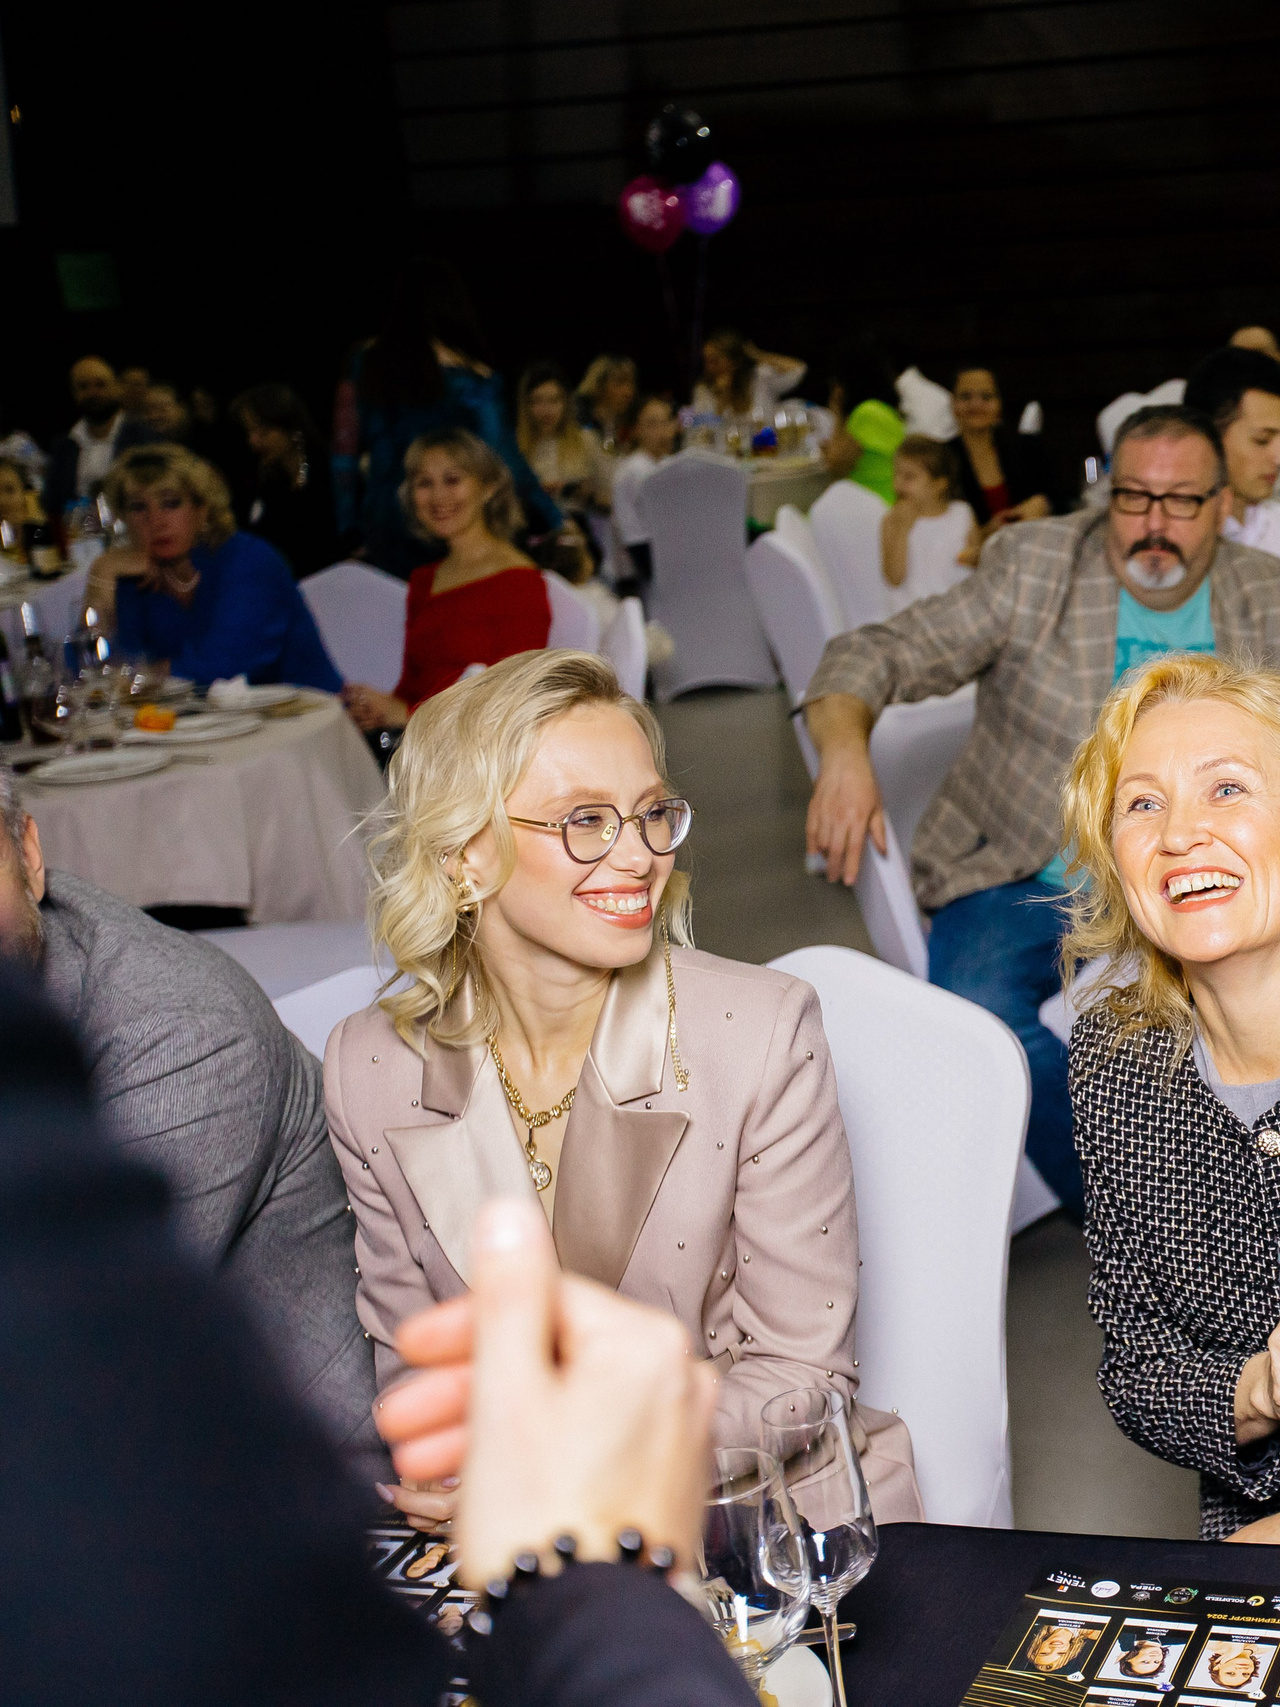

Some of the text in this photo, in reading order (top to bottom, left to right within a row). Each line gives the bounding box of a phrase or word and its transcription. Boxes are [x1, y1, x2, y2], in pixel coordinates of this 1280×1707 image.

[1059, 1570, 1082, 1580] HOTEL
[1047, 1573, 1086, 1588] TENET
[1130, 1584, 1162, 1592] ОПЕРА
[1205, 1596, 1246, 1604] GOLDFIELD
